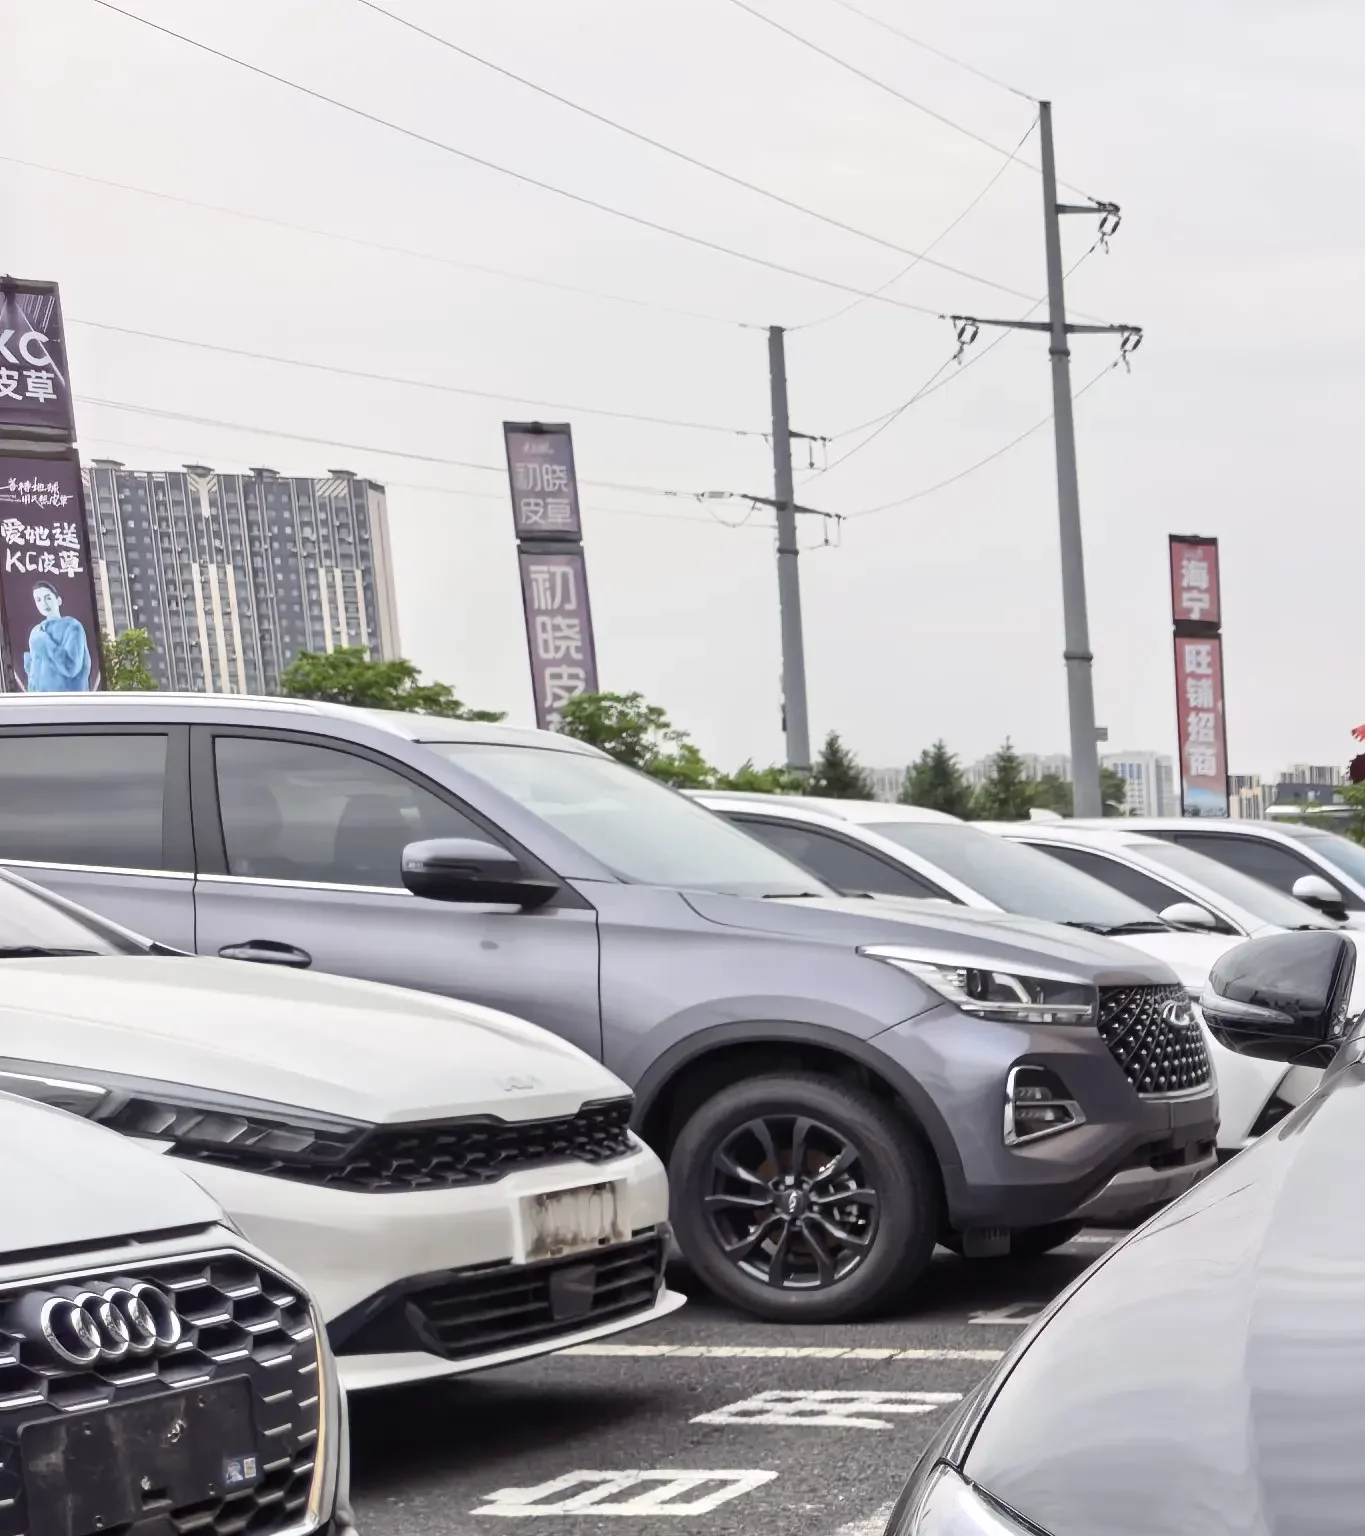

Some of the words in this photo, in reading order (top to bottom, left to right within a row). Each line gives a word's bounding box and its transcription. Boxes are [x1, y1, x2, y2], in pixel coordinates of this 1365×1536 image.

[0, 366, 57, 403] 皮草
[512, 462, 569, 492] 初晓
[519, 497, 572, 525] 皮草
[1, 518, 80, 549] 爱她送
[5, 548, 83, 577] KC皮草
[529, 565, 586, 731] 初晓皮
